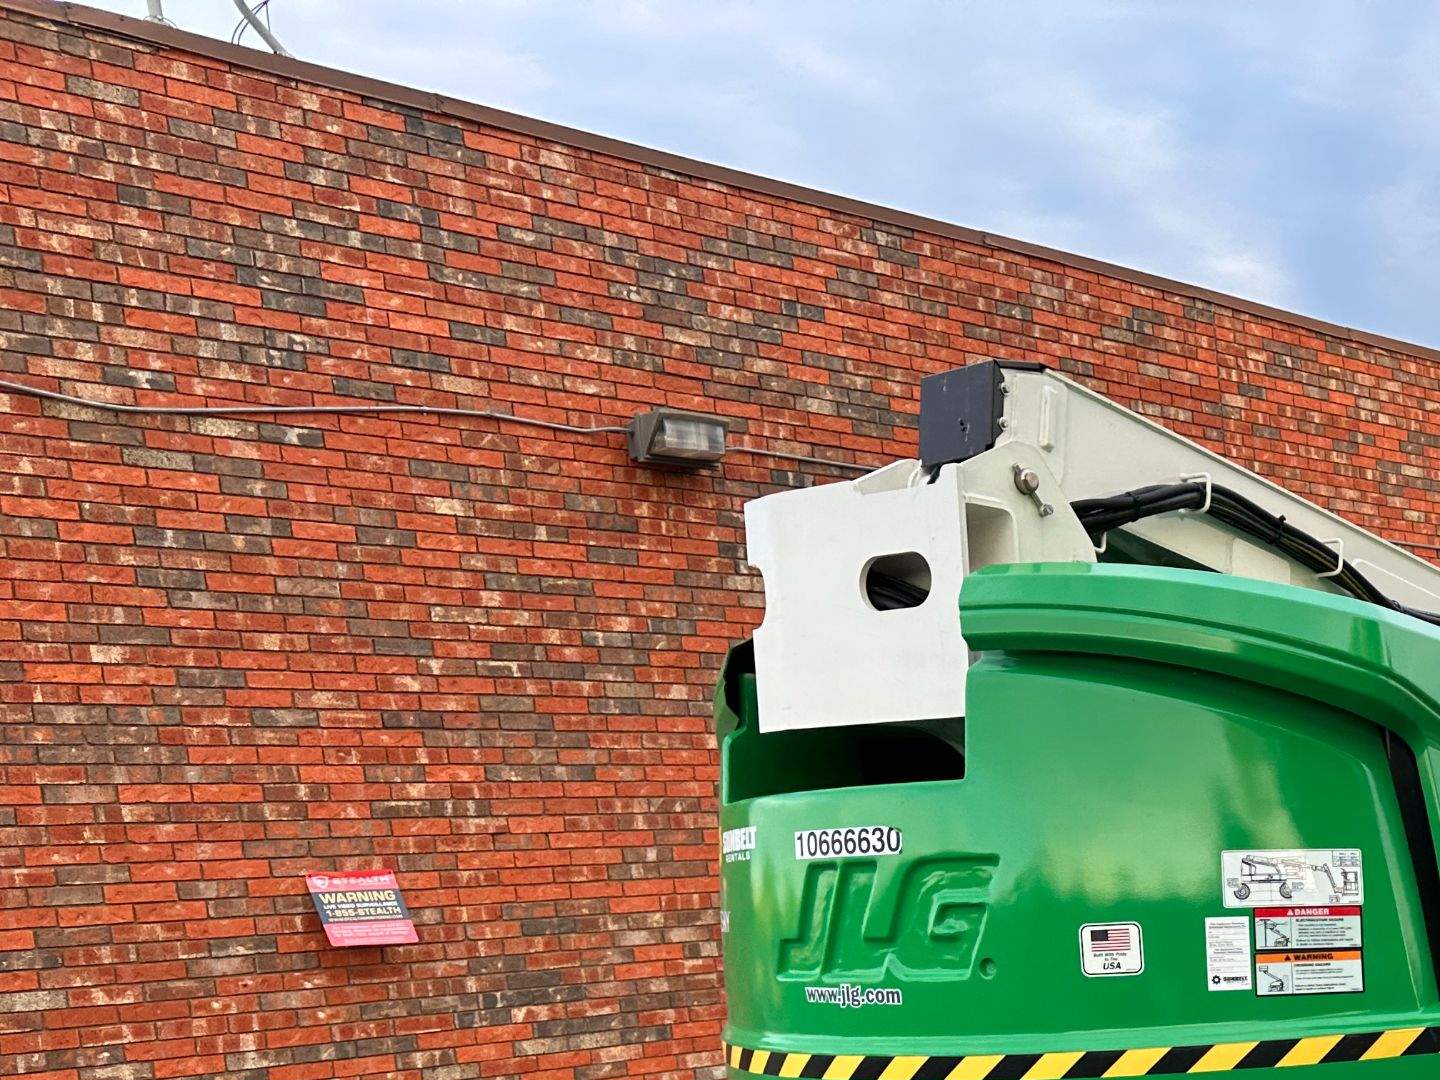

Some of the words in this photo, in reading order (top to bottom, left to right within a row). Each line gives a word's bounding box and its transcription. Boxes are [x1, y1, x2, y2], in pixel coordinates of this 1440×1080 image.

[796, 827, 902, 857] 10666630
[319, 890, 396, 904] WARNING
[1294, 908, 1330, 916] DANGER
[1103, 962, 1121, 970] USA
[805, 985, 902, 1007] www.jlg.com
